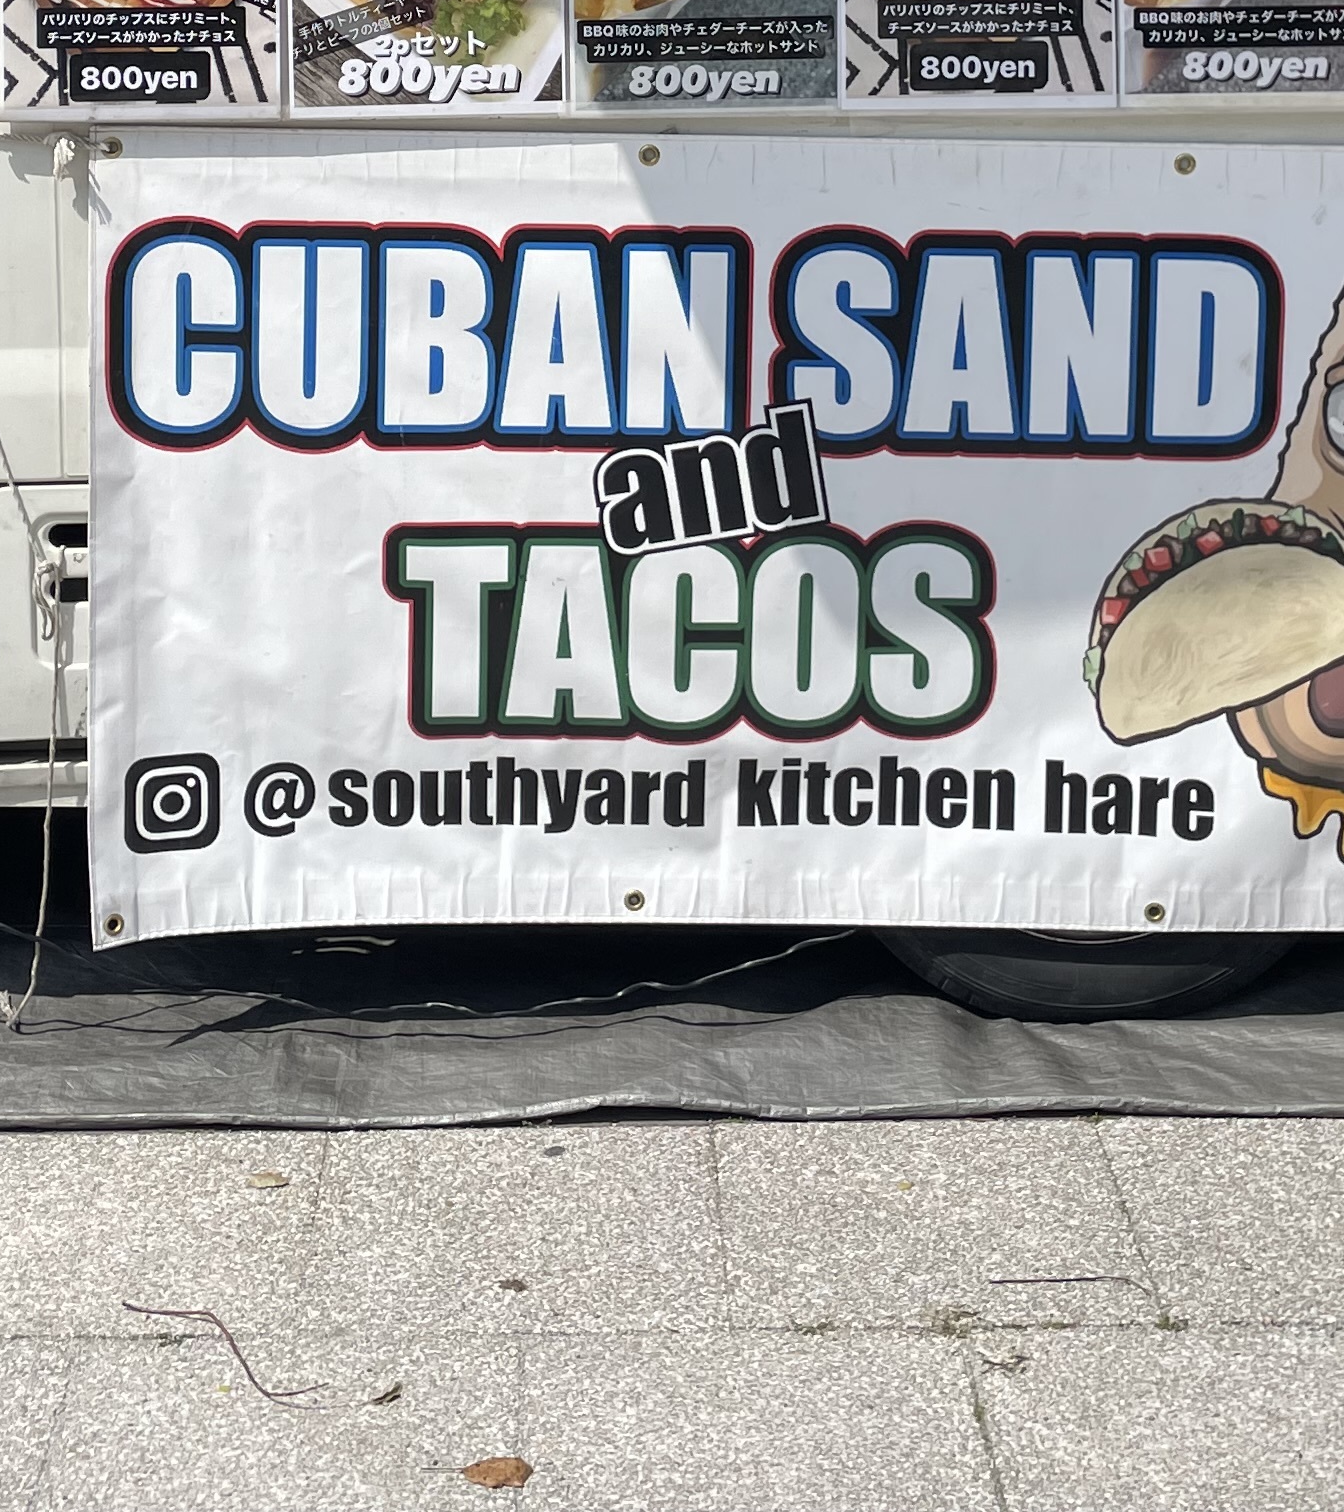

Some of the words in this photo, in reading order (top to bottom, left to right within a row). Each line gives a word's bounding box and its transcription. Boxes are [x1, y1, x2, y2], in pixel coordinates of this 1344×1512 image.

[47, 29, 236, 45] チーズソースがかかったナチョス
[373, 29, 488, 63] 2pセット
[887, 19, 1074, 35] チーズソースがかかったナチョス
[80, 65, 198, 94] 800yen
[337, 56, 522, 104] 800yen
[628, 64, 783, 102] 800yen
[920, 55, 1036, 83] 800yen
[1182, 50, 1330, 89] 800yen
[122, 237, 738, 434] CUBAN
[785, 245, 1265, 444] SAND
[593, 398, 825, 554] and
[398, 536, 979, 730] TACOS
[735, 756, 1015, 832] kitchen
[1044, 759, 1215, 841] hare
